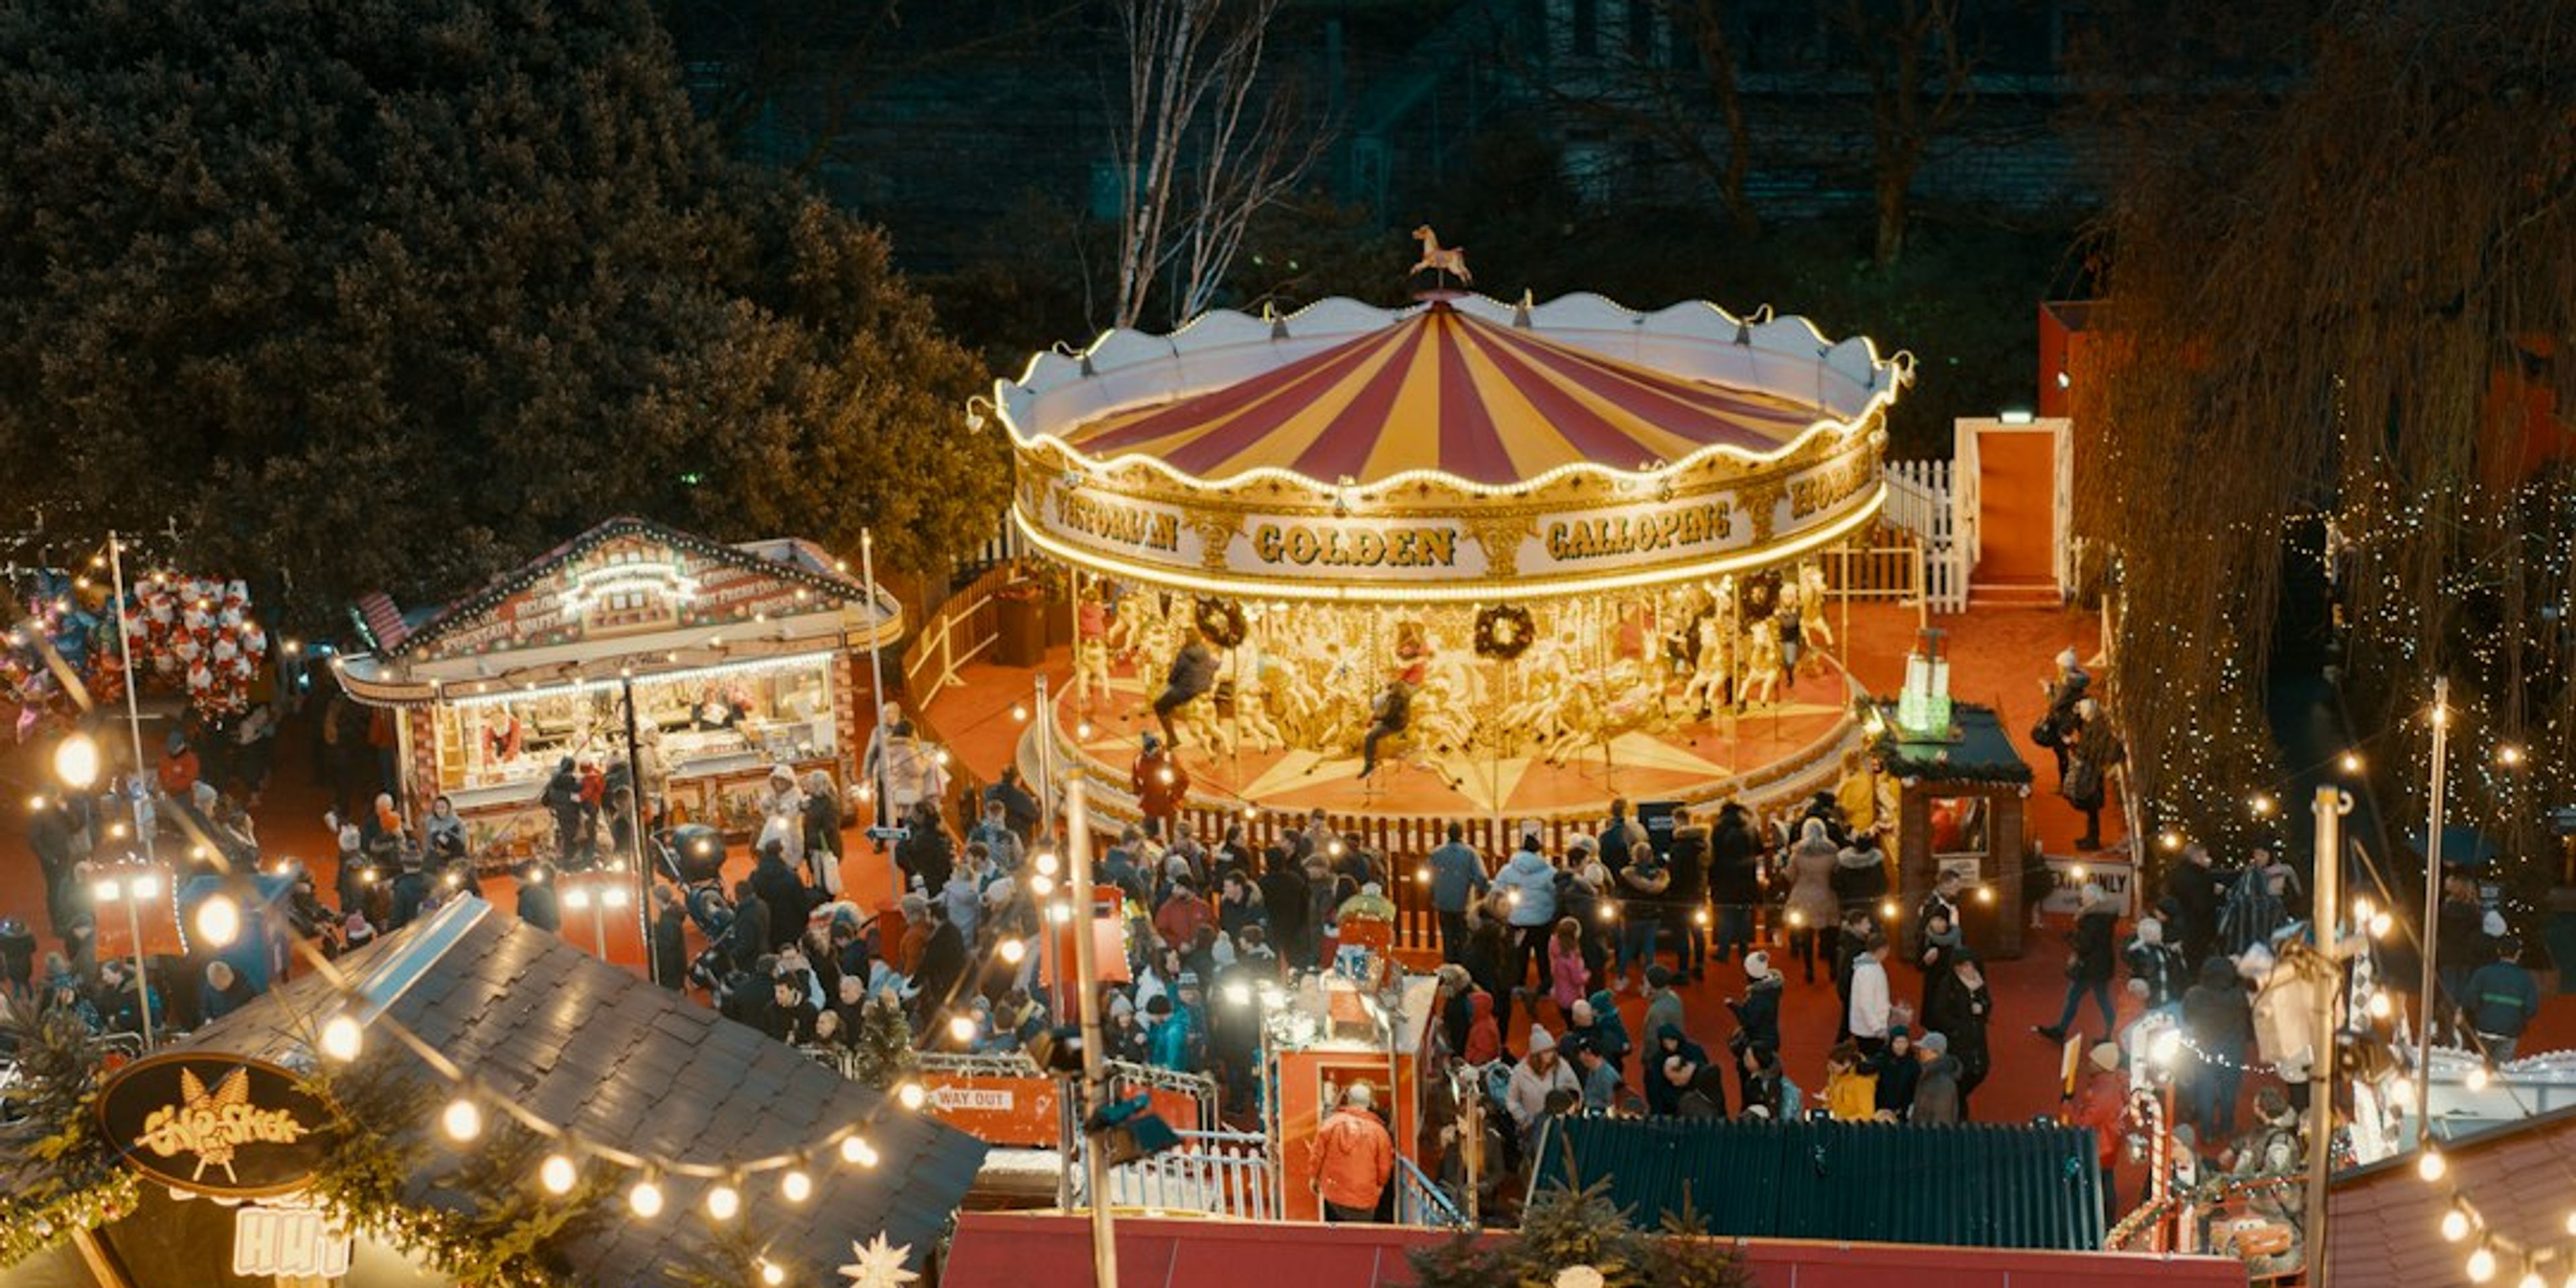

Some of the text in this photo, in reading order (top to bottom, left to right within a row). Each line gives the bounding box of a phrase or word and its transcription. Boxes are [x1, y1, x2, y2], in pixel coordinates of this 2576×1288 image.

[1055, 486, 1177, 551] VICTORIAN
[1546, 500, 1730, 560] GALLOPING
[1253, 523, 1456, 566] GOLDEN
[2087, 873, 2126, 893] ONLY
[938, 1091, 1003, 1106] WAY OUT
[236, 1208, 348, 1276] HUT
